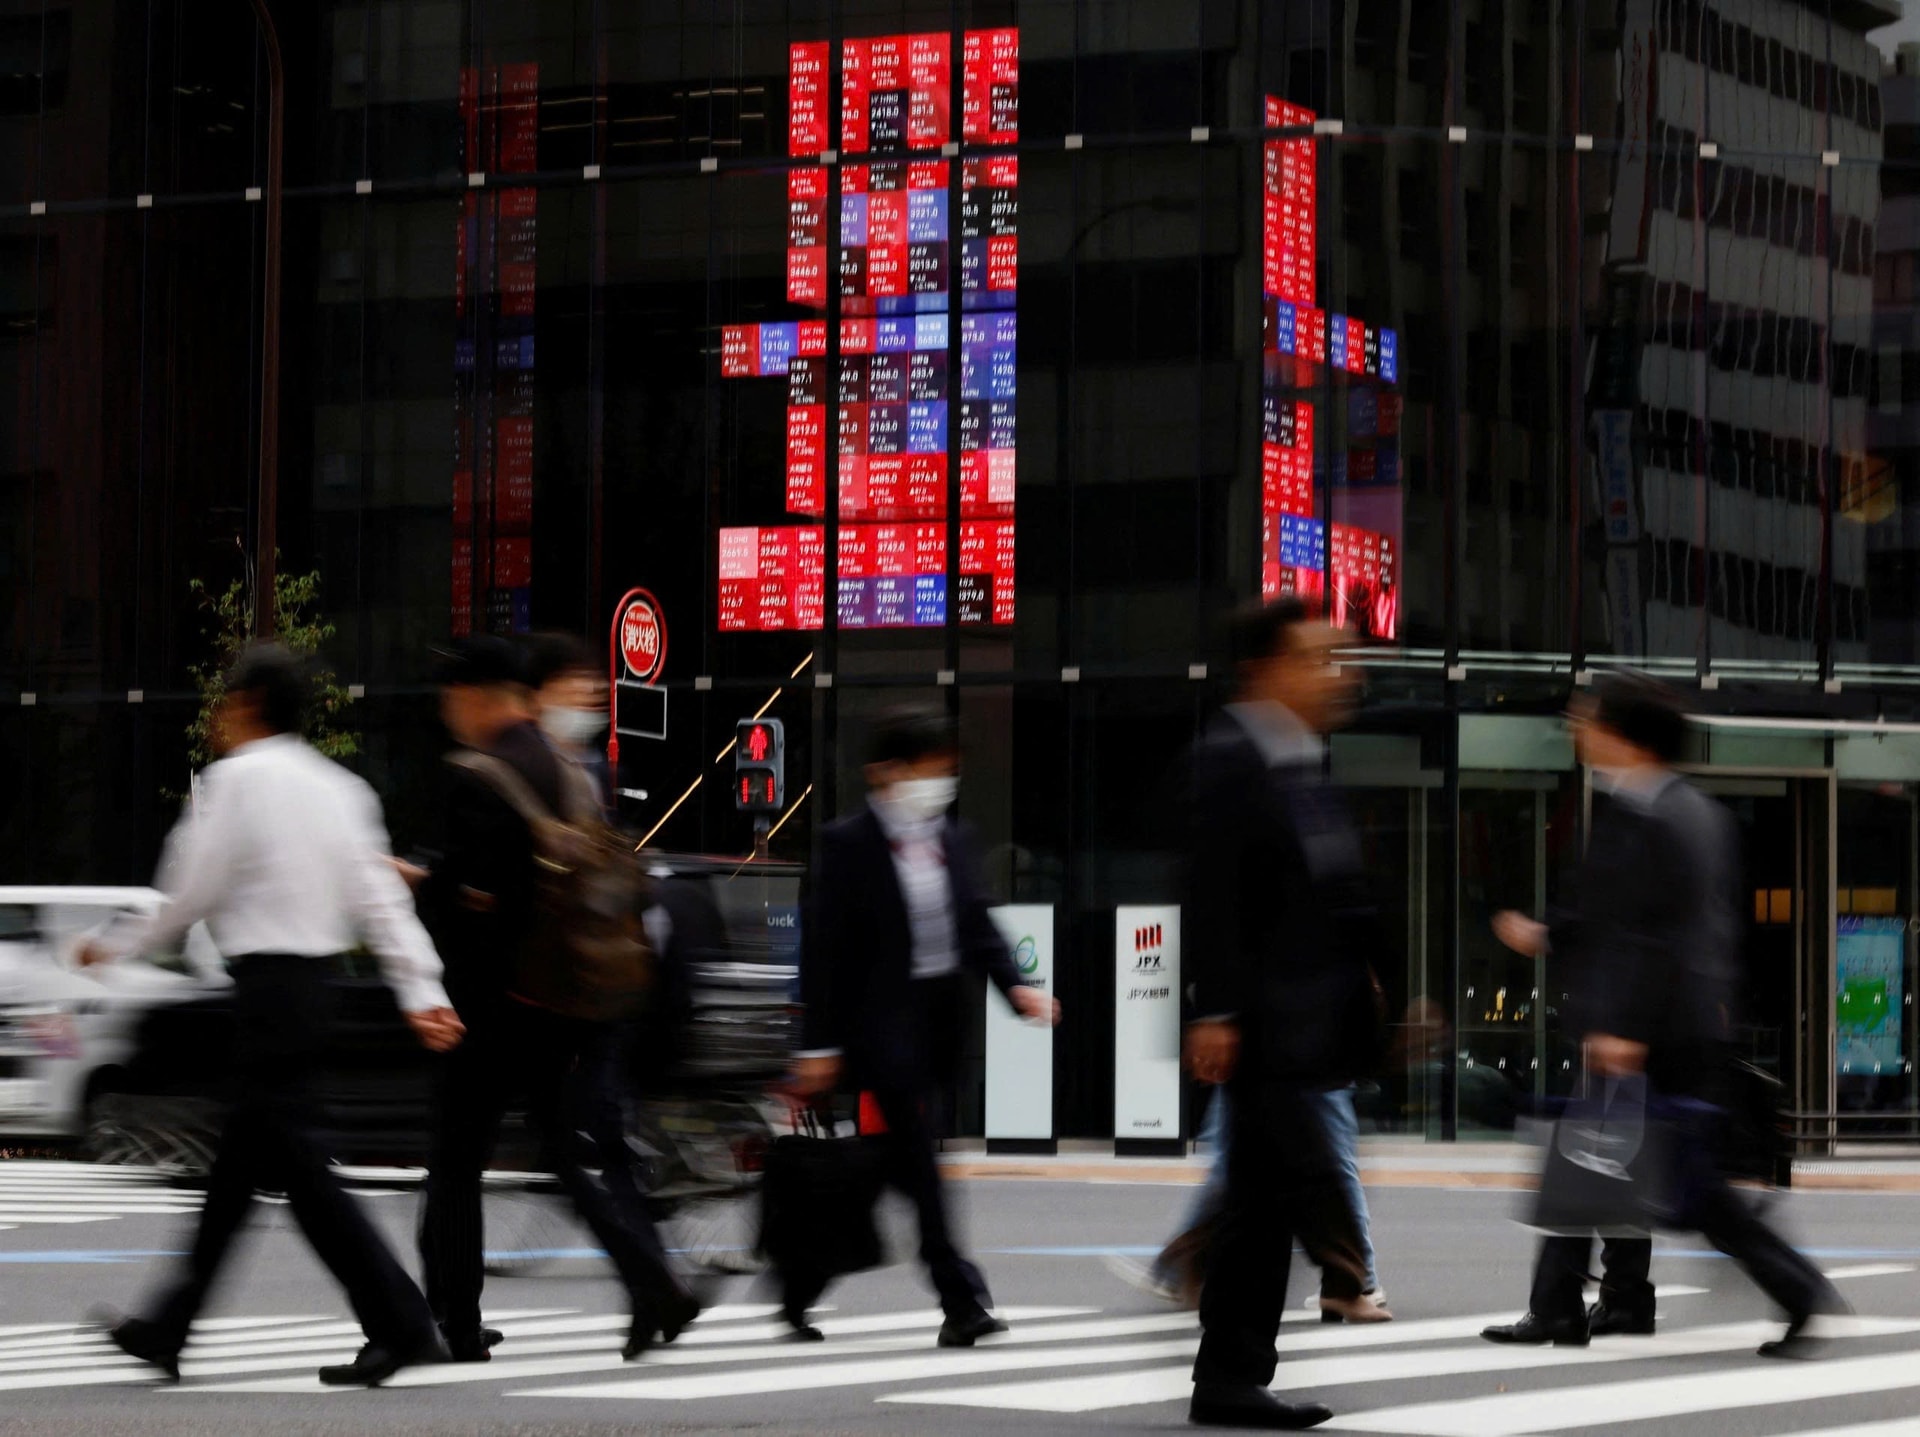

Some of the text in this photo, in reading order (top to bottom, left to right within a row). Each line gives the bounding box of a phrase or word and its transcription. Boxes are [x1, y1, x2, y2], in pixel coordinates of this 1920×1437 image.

[625, 621, 656, 655] 消火栓
[1136, 955, 1161, 968] JPX
